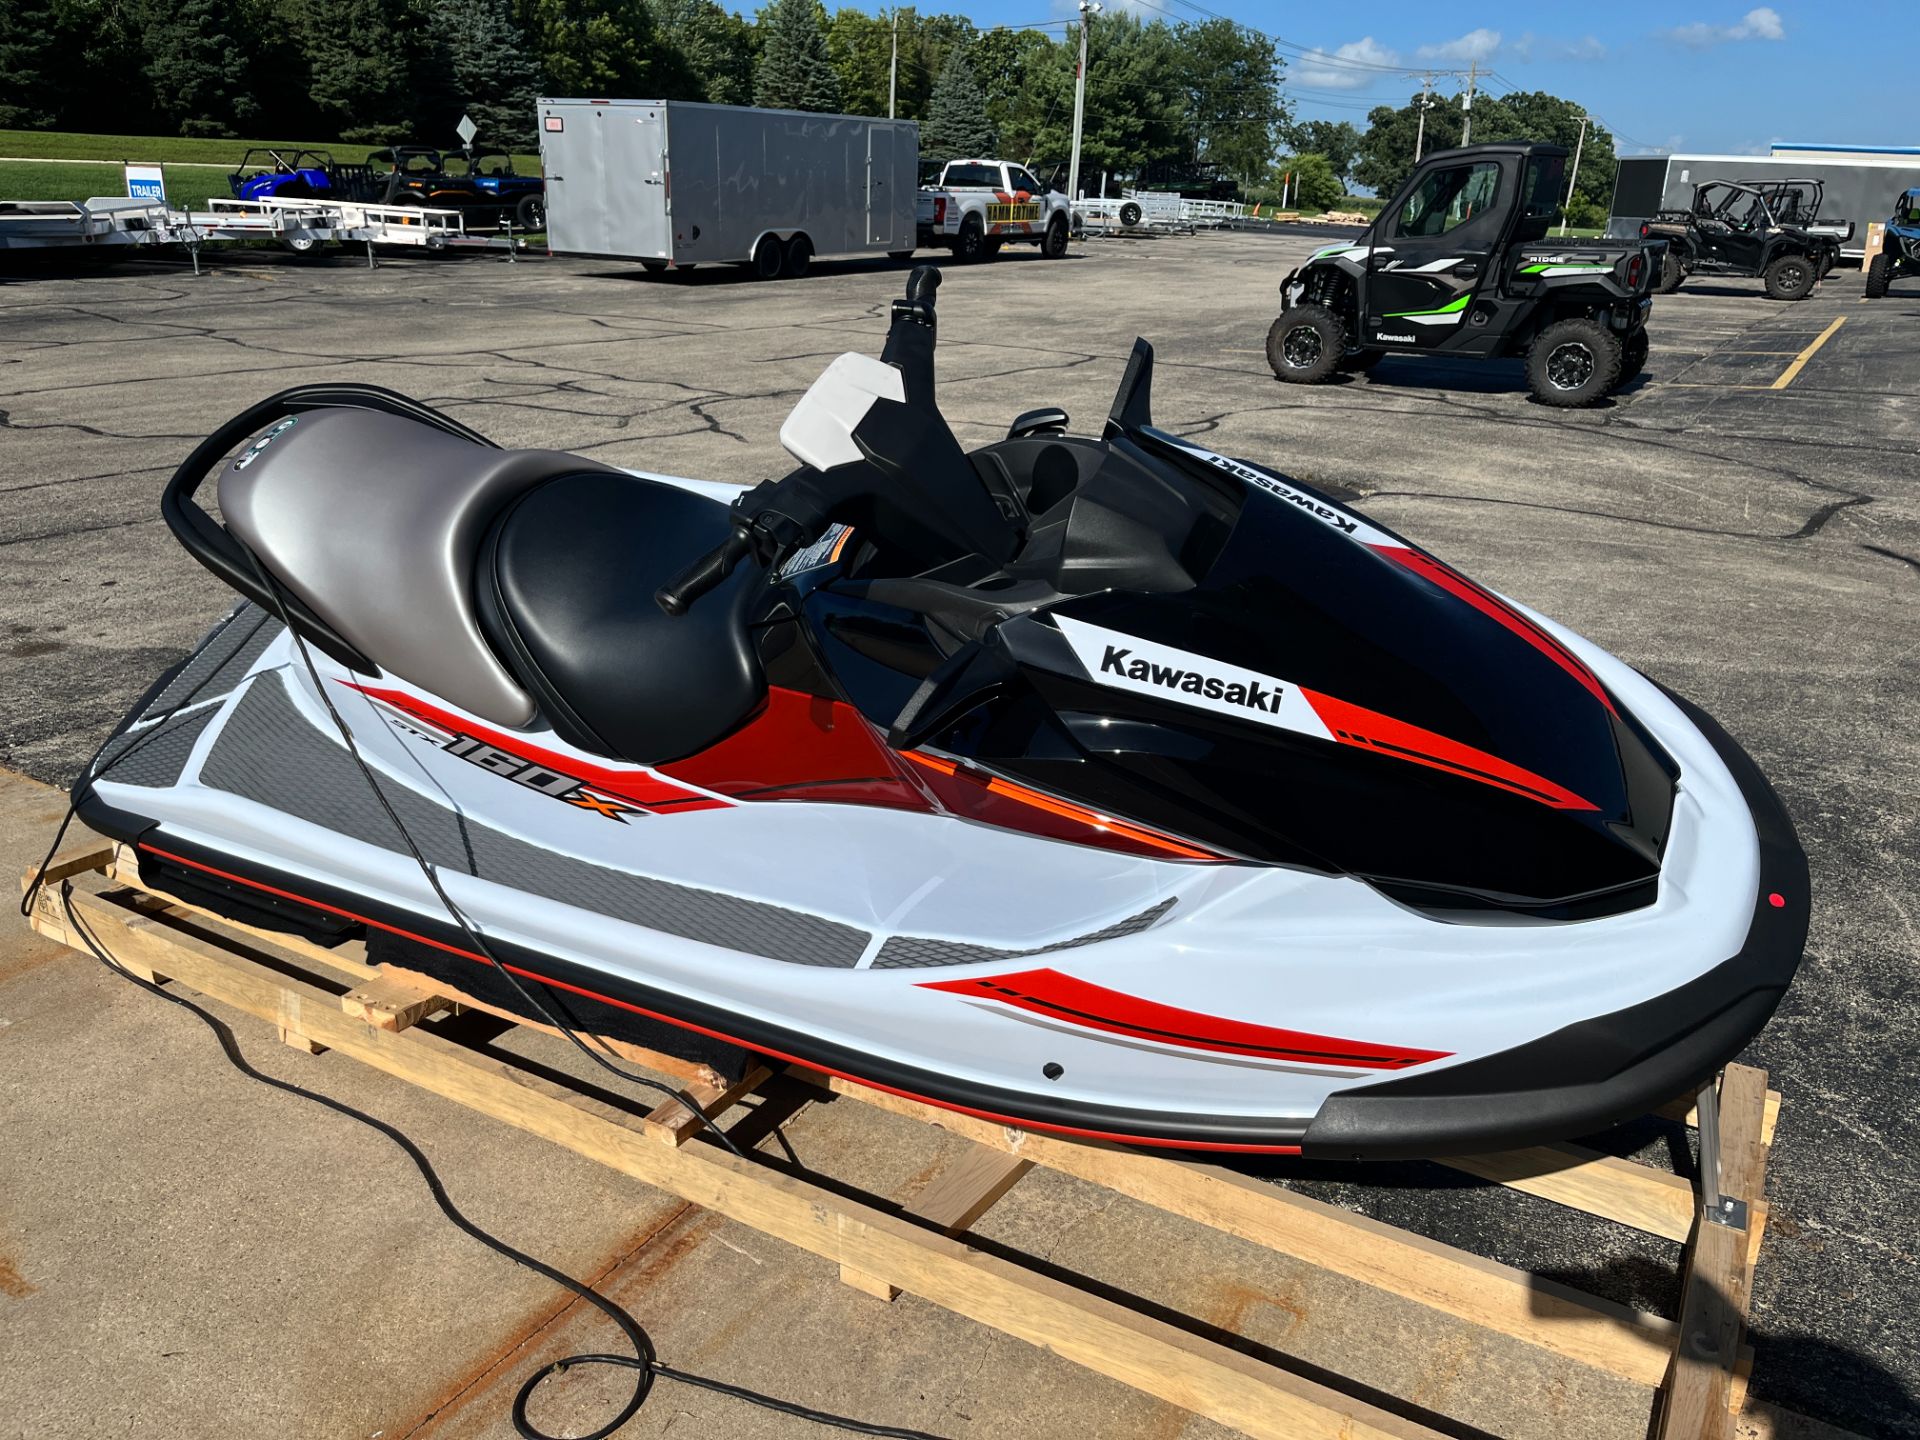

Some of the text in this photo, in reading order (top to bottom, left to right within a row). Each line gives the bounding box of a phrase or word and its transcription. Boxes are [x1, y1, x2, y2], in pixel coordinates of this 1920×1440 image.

[131, 184, 162, 198] TRAILER
[1376, 332, 1416, 343] Kawasaki
[1207, 455, 1358, 535] Kawasaki
[1100, 645, 1284, 714] Kawasaki
